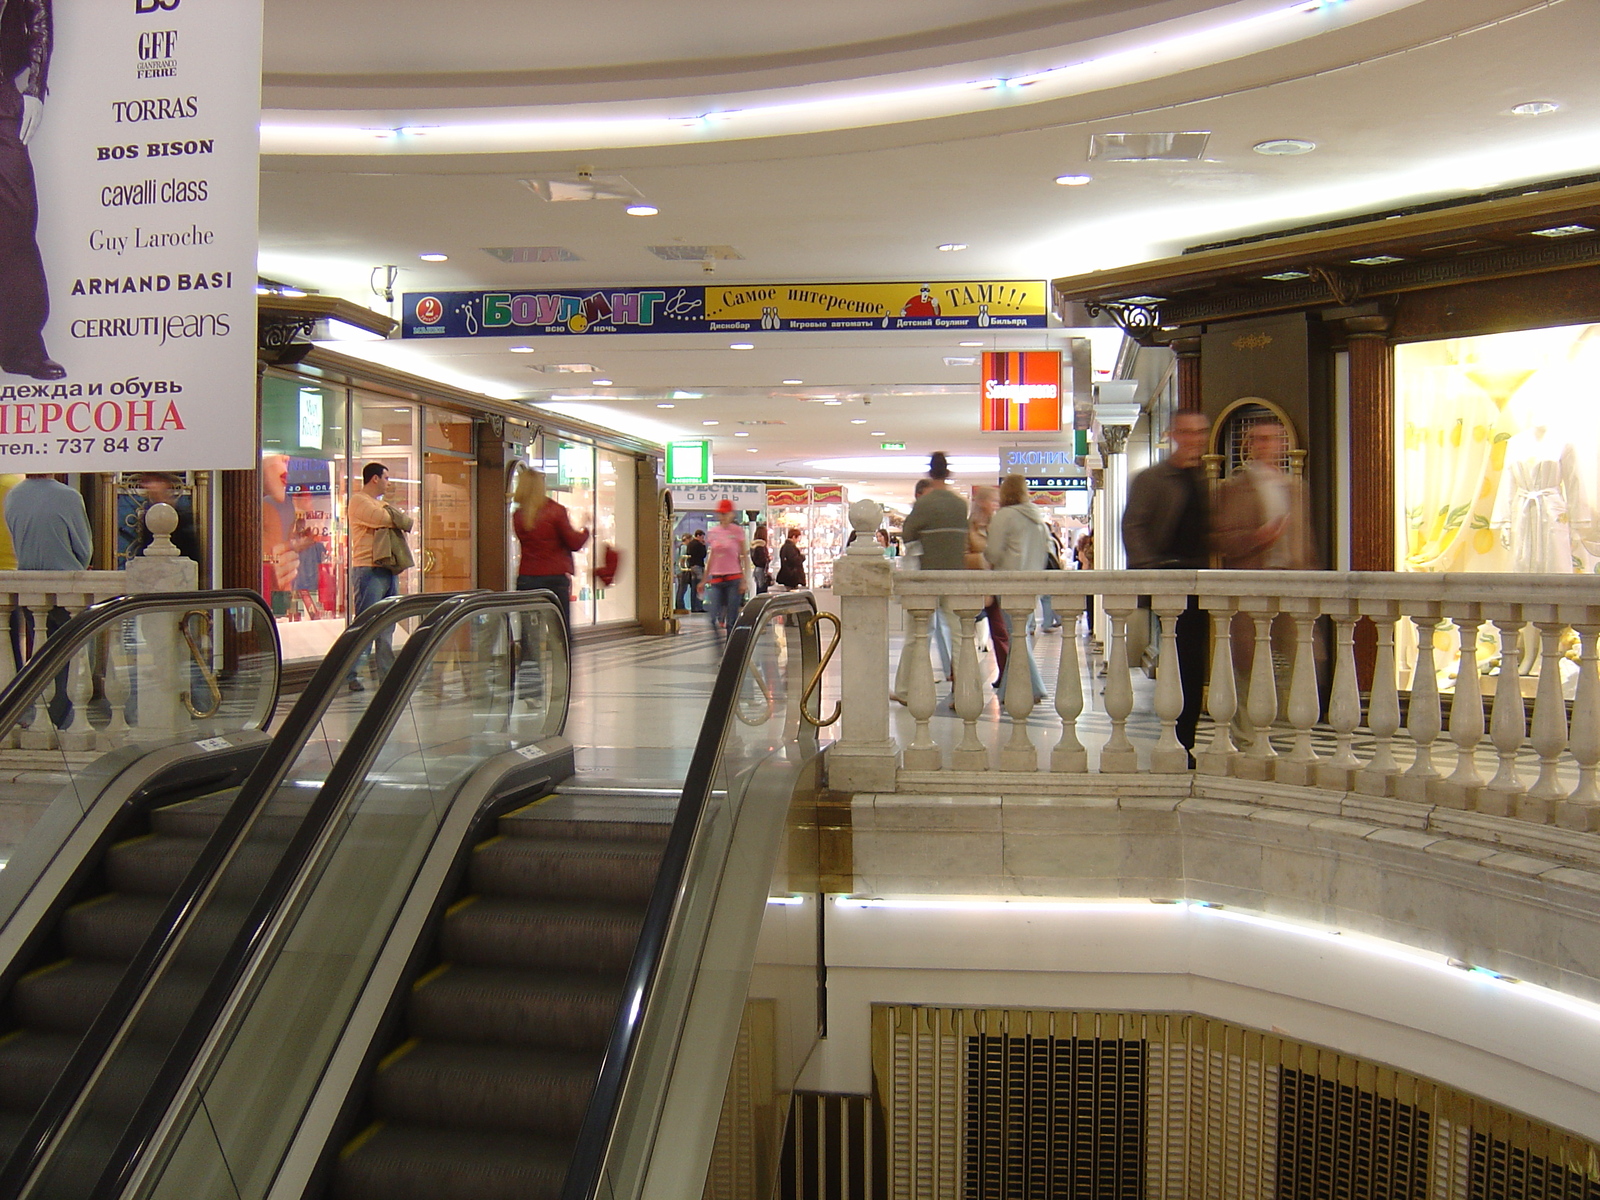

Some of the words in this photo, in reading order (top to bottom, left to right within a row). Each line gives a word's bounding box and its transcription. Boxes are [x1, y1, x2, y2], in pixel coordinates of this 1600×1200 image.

[138, 30, 178, 60] GFF
[136, 60, 177, 70] GIANFRANCO
[137, 68, 177, 79] FERRE
[112, 96, 198, 123] TORRAS
[97, 145, 139, 161] BOS
[147, 139, 214, 158] BISON
[101, 179, 157, 207] cavalli
[161, 178, 208, 202] class
[89, 229, 128, 256] Guy
[135, 224, 214, 248] Laroche
[71, 275, 171, 295] ARMAND
[177, 271, 232, 291] BASI
[425, 299, 434, 316] 2
[483, 291, 665, 327] БОУЛИНГ
[788, 289, 884, 315] интересное
[790, 320, 827, 328] Игровые
[896, 319, 932, 328] Детский
[990, 317, 1027, 326] Бильярд
[0, 382, 83, 400] дежда
[88, 383, 103, 396] и
[110, 377, 183, 399] обувь
[0, 441, 48, 456] тел.:
[56, 437, 96, 454] 737
[103, 437, 130, 453] 84
[137, 436, 164, 452] 87
[1007, 451, 1072, 465] ЭКОНИК
[672, 484, 759, 493] ПРЕСТИЖ
[687, 493, 740, 501] ОБУВЬ
